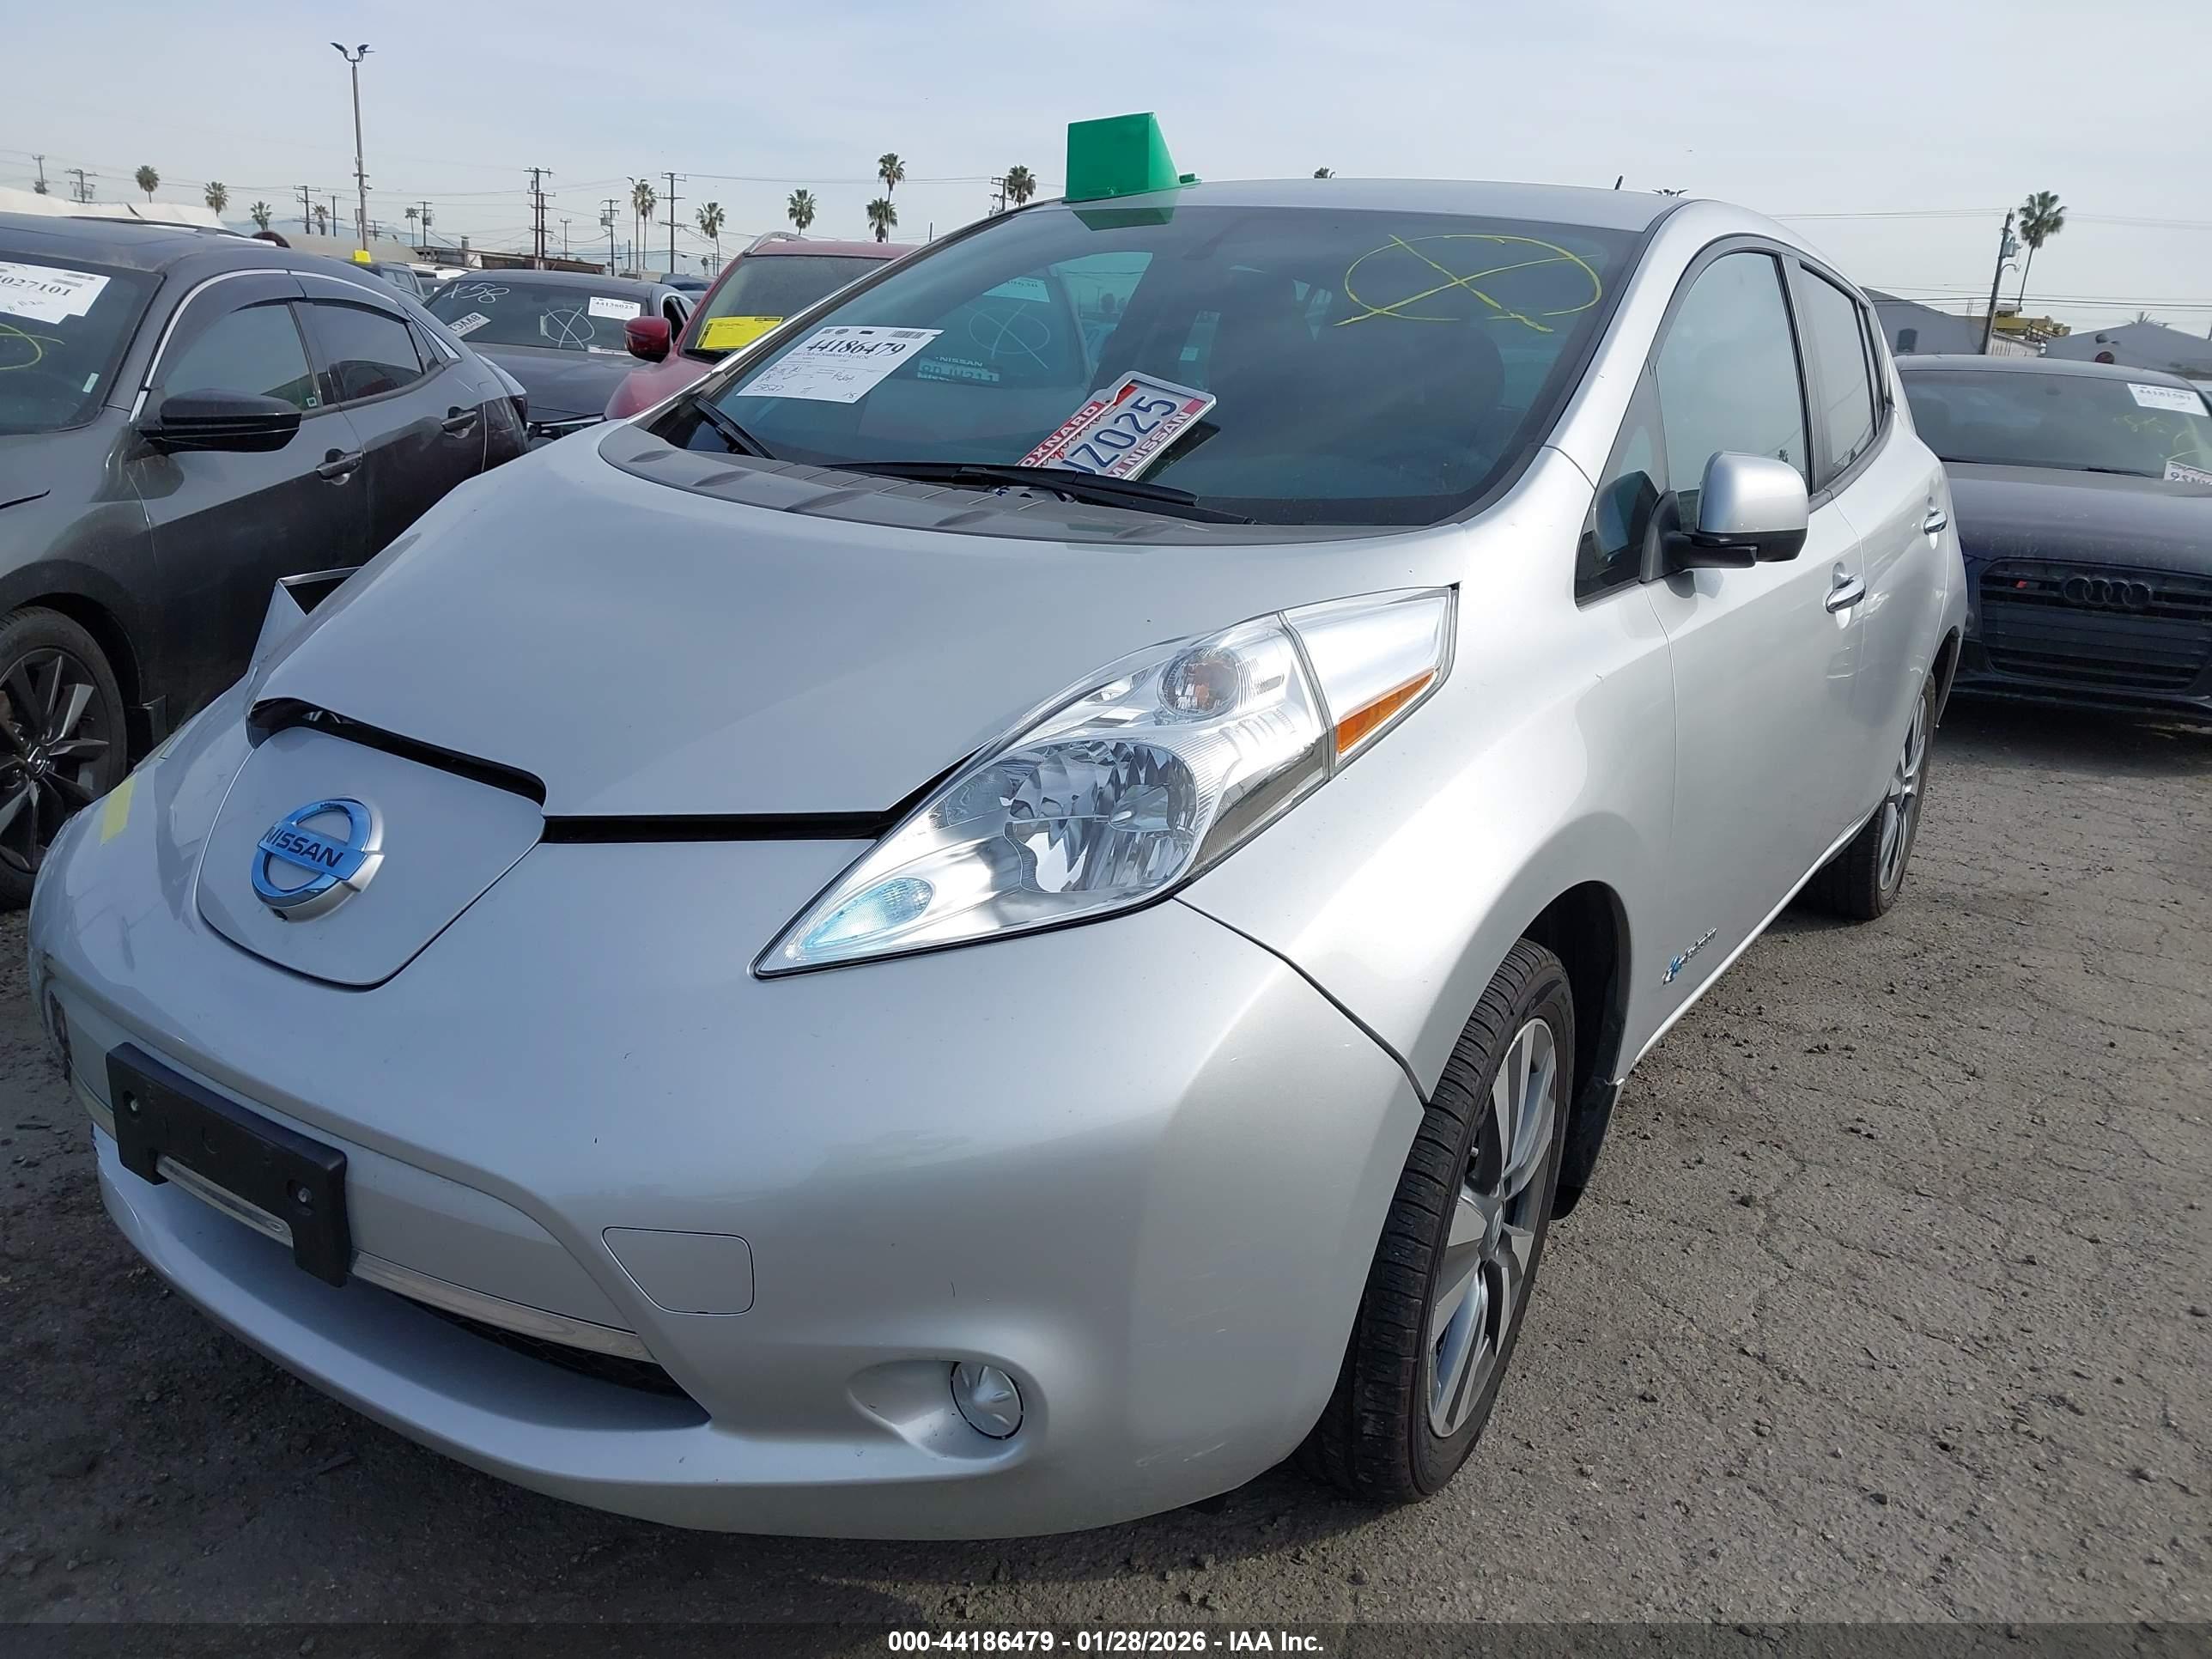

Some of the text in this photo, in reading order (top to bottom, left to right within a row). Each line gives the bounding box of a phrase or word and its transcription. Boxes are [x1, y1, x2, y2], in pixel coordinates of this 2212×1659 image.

[0, 274, 71, 296] 027101
[806, 339, 906, 356] 44186479
[939, 356, 983, 368] NISSAN
[1020, 405, 1099, 467] OXNARD
[1122, 411, 1191, 466] NISSAN
[263, 826, 343, 868] NISSAN
